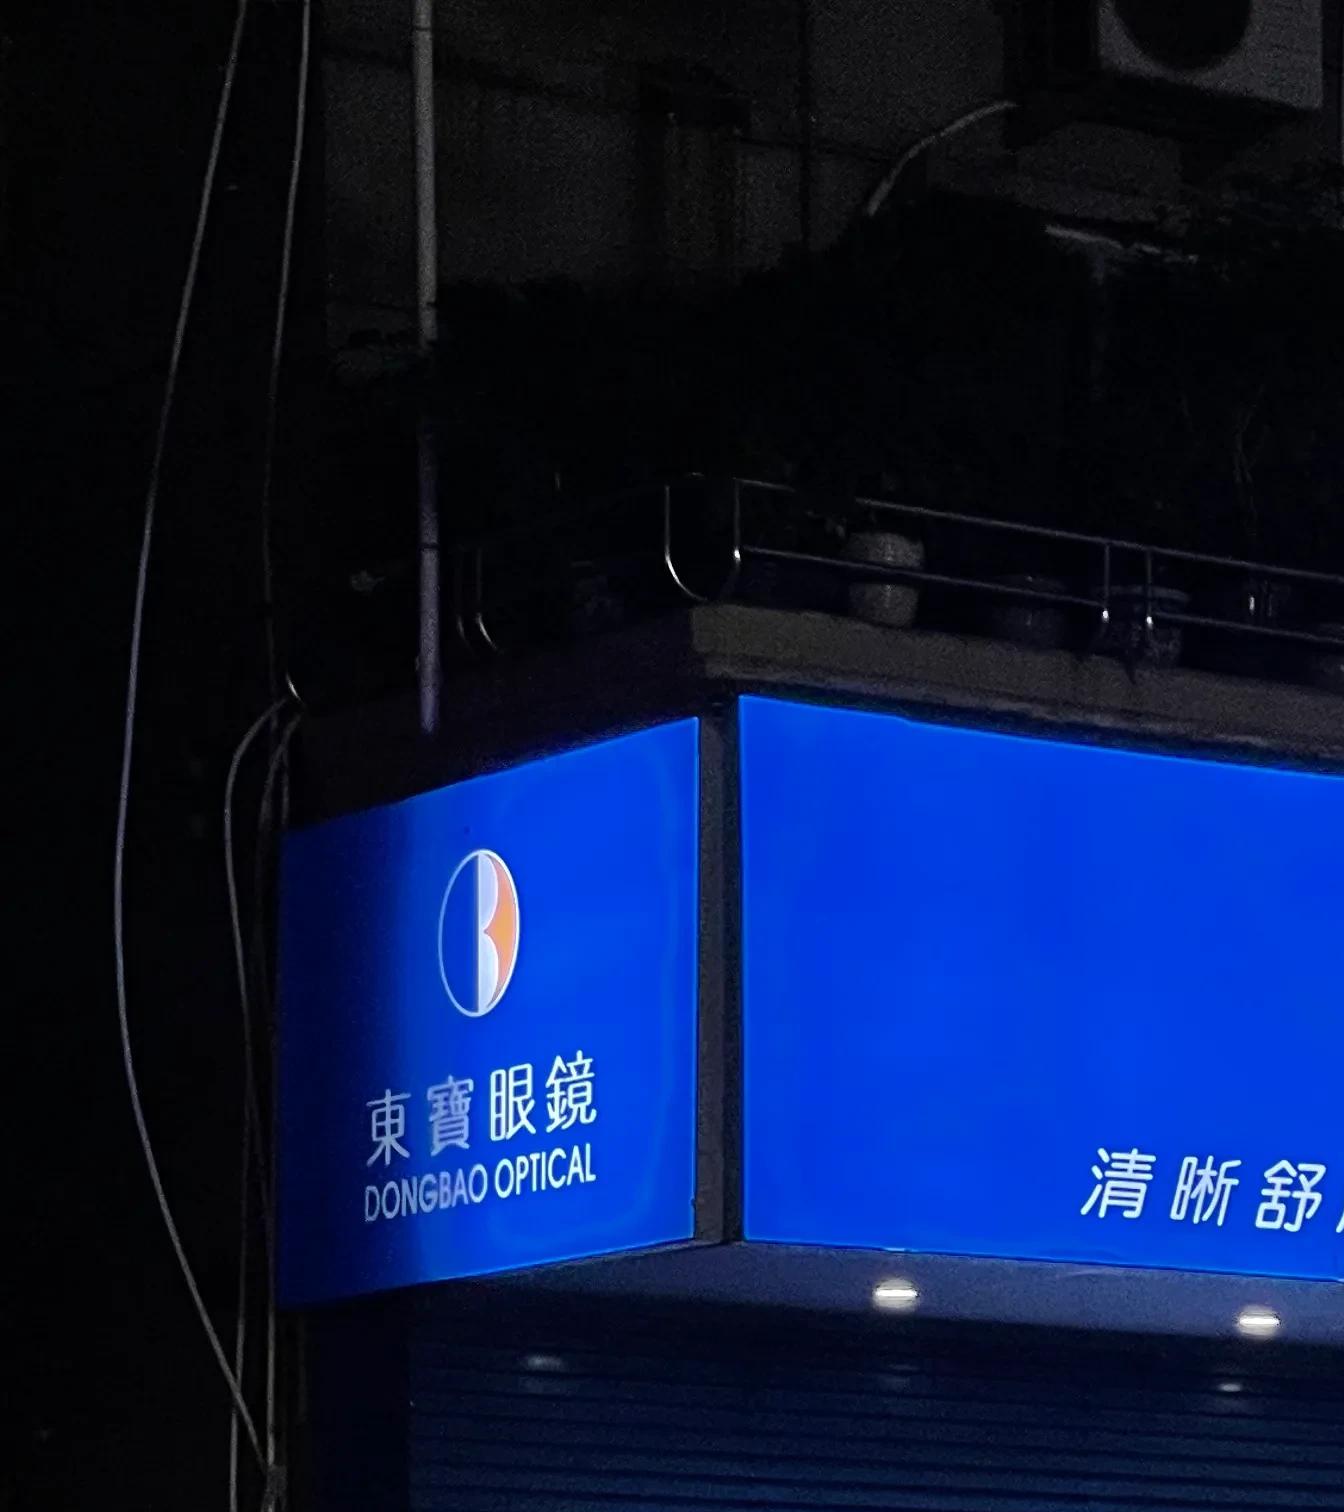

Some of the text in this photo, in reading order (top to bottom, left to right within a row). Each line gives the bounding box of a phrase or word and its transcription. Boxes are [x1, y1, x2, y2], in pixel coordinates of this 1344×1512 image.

[366, 1050, 597, 1167] 東寶眼鏡
[364, 1143, 597, 1222] DONGBAO OPTICAL
